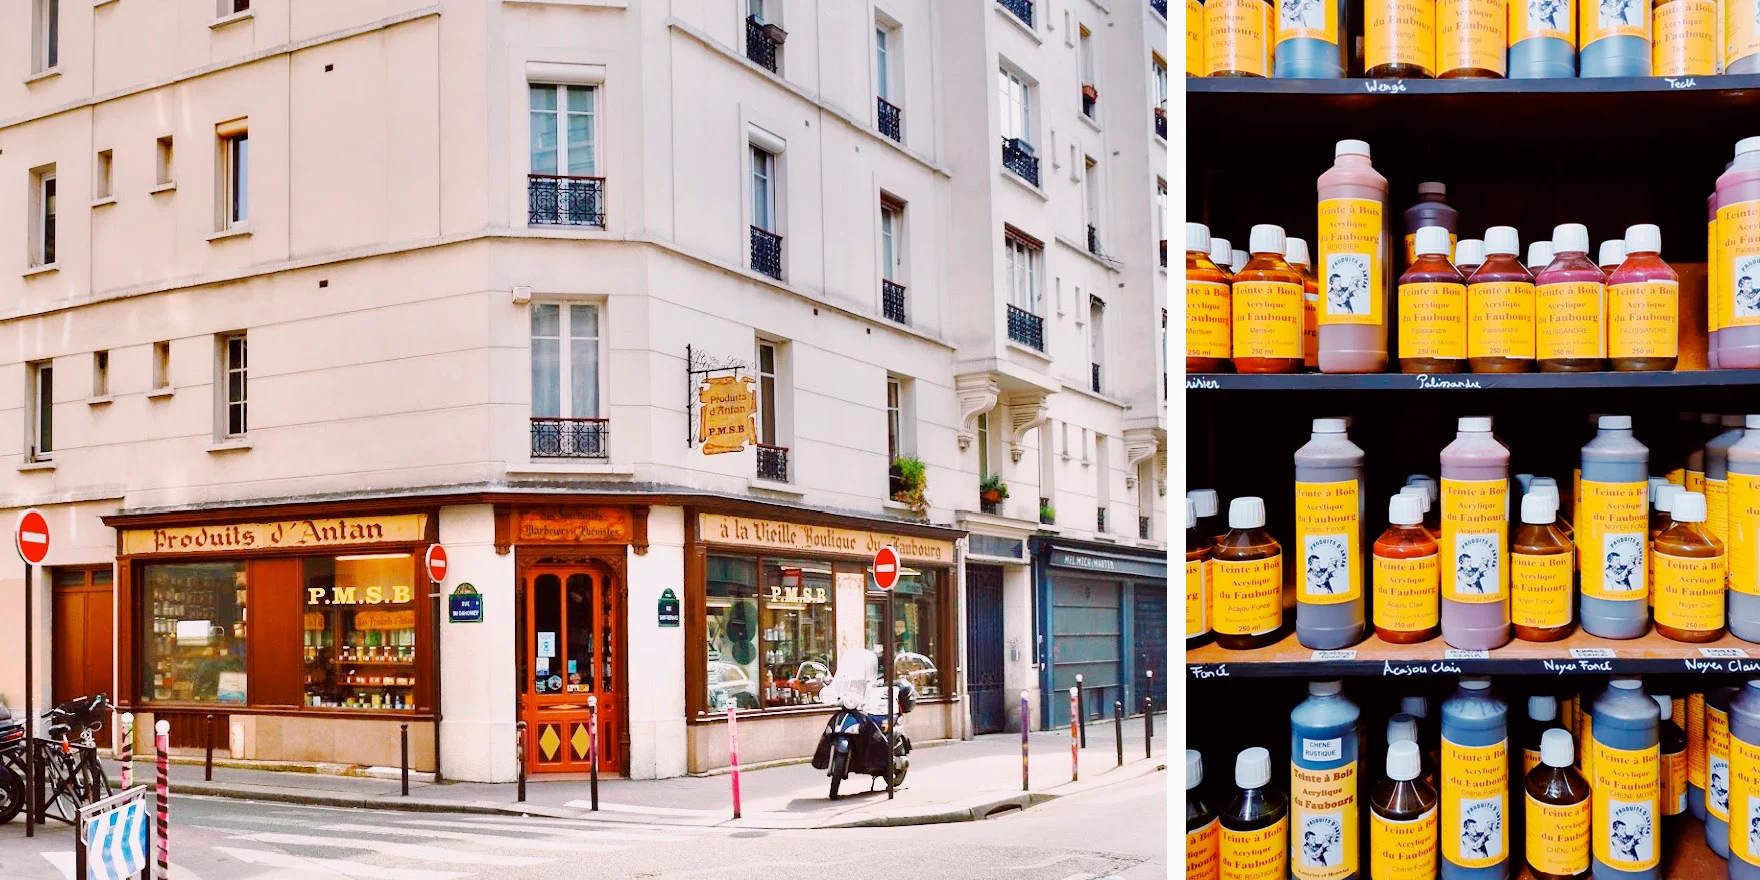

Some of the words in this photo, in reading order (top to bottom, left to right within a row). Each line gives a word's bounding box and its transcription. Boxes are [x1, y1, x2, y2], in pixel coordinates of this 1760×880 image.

[1652, 4, 1679, 21] Teinte
[1210, 26, 1259, 39] Faubourg
[1366, 80, 1406, 93] Wengé
[1320, 206, 1346, 216] Teinte
[1349, 205, 1355, 213] à
[1359, 206, 1379, 216] Bois
[1725, 209, 1758, 220] Teinte
[1329, 220, 1367, 228] Acrylique
[1724, 239, 1735, 247] du
[1332, 256, 1358, 270] PRODUITS
[1236, 287, 1264, 295] Teinte
[1266, 285, 1273, 294] à
[1277, 287, 1296, 296] Bois
[1402, 288, 1430, 296] Teinte
[1442, 287, 1461, 296] Bois
[1473, 287, 1502, 295] Teinte
[1514, 286, 1532, 295] Bois
[1539, 289, 1564, 298] Teinte
[1577, 286, 1598, 294] Bois
[1615, 288, 1646, 296] Teinte
[1659, 287, 1676, 295] Bois
[1246, 301, 1285, 309] Acrylique
[1247, 313, 1297, 323] Faubourg
[1414, 313, 1461, 323] Faubourg
[1485, 312, 1531, 322] Faubourg
[1629, 313, 1676, 322] Faubourg
[1416, 374, 1481, 389] Palissandre
[711, 395, 746, 404] Produits
[709, 425, 745, 435] P.M.S.B
[1298, 489, 1322, 497] Teinte
[1326, 489, 1331, 497] à
[1335, 487, 1355, 496] Bois
[1448, 487, 1476, 496] Teinte
[1489, 487, 1506, 495] Bois
[1458, 502, 1496, 510] Acrylique
[1460, 513, 1506, 522] Faubourg
[153, 526, 255, 551] Produits
[720, 518, 728, 538] à
[735, 519, 748, 540] la
[753, 521, 797, 545] Vieille
[803, 525, 856, 550] Boutique
[867, 534, 880, 551] du
[888, 535, 941, 559] Faubourg
[1310, 539, 1336, 551] PRODUITS
[1337, 544, 1347, 568] D'ANTAN
[1462, 538, 1488, 550] PRODUITS
[1488, 543, 1497, 568] D'ANTAN
[1220, 565, 1250, 573] Teinte
[1263, 561, 1280, 570] Bois
[1379, 561, 1406, 571] Teinte
[1419, 561, 1435, 569] Bois
[1519, 573, 1556, 581] Acrylique
[1232, 578, 1271, 588] Acrylique
[308, 586, 410, 604] P.M.S.B
[771, 586, 827, 603] P.M.S.B
[1220, 591, 1230, 599] du
[1234, 586, 1280, 599] Faubourg
[1378, 586, 1387, 594] du
[1391, 586, 1436, 596] Faubourg
[1252, 602, 1270, 610] Foncé
[1679, 601, 1698, 609] Noyer
[1190, 664, 1229, 678] Foncé
[1383, 659, 1427, 676] Acajou
[1543, 659, 1576, 675] Noyer
[1684, 658, 1723, 673] Noyer
[1601, 750, 1630, 764] Teinte
[1294, 769, 1322, 782] Teinte
[1333, 768, 1353, 780] Bois
[1464, 766, 1500, 776] Acrylique
[1611, 769, 1649, 778] Acrylique
[1600, 776, 1610, 786] du
[1302, 788, 1342, 797] Acrylique
[1190, 837, 1196, 845] à
[1200, 827, 1217, 842] Bois
[1223, 832, 1251, 843] Teinte
[1254, 834, 1260, 842] à
[1264, 827, 1282, 839] Bois
[1233, 846, 1271, 857] Acrylique
[1223, 858, 1232, 867] du
[1235, 851, 1283, 869] Faubourg
